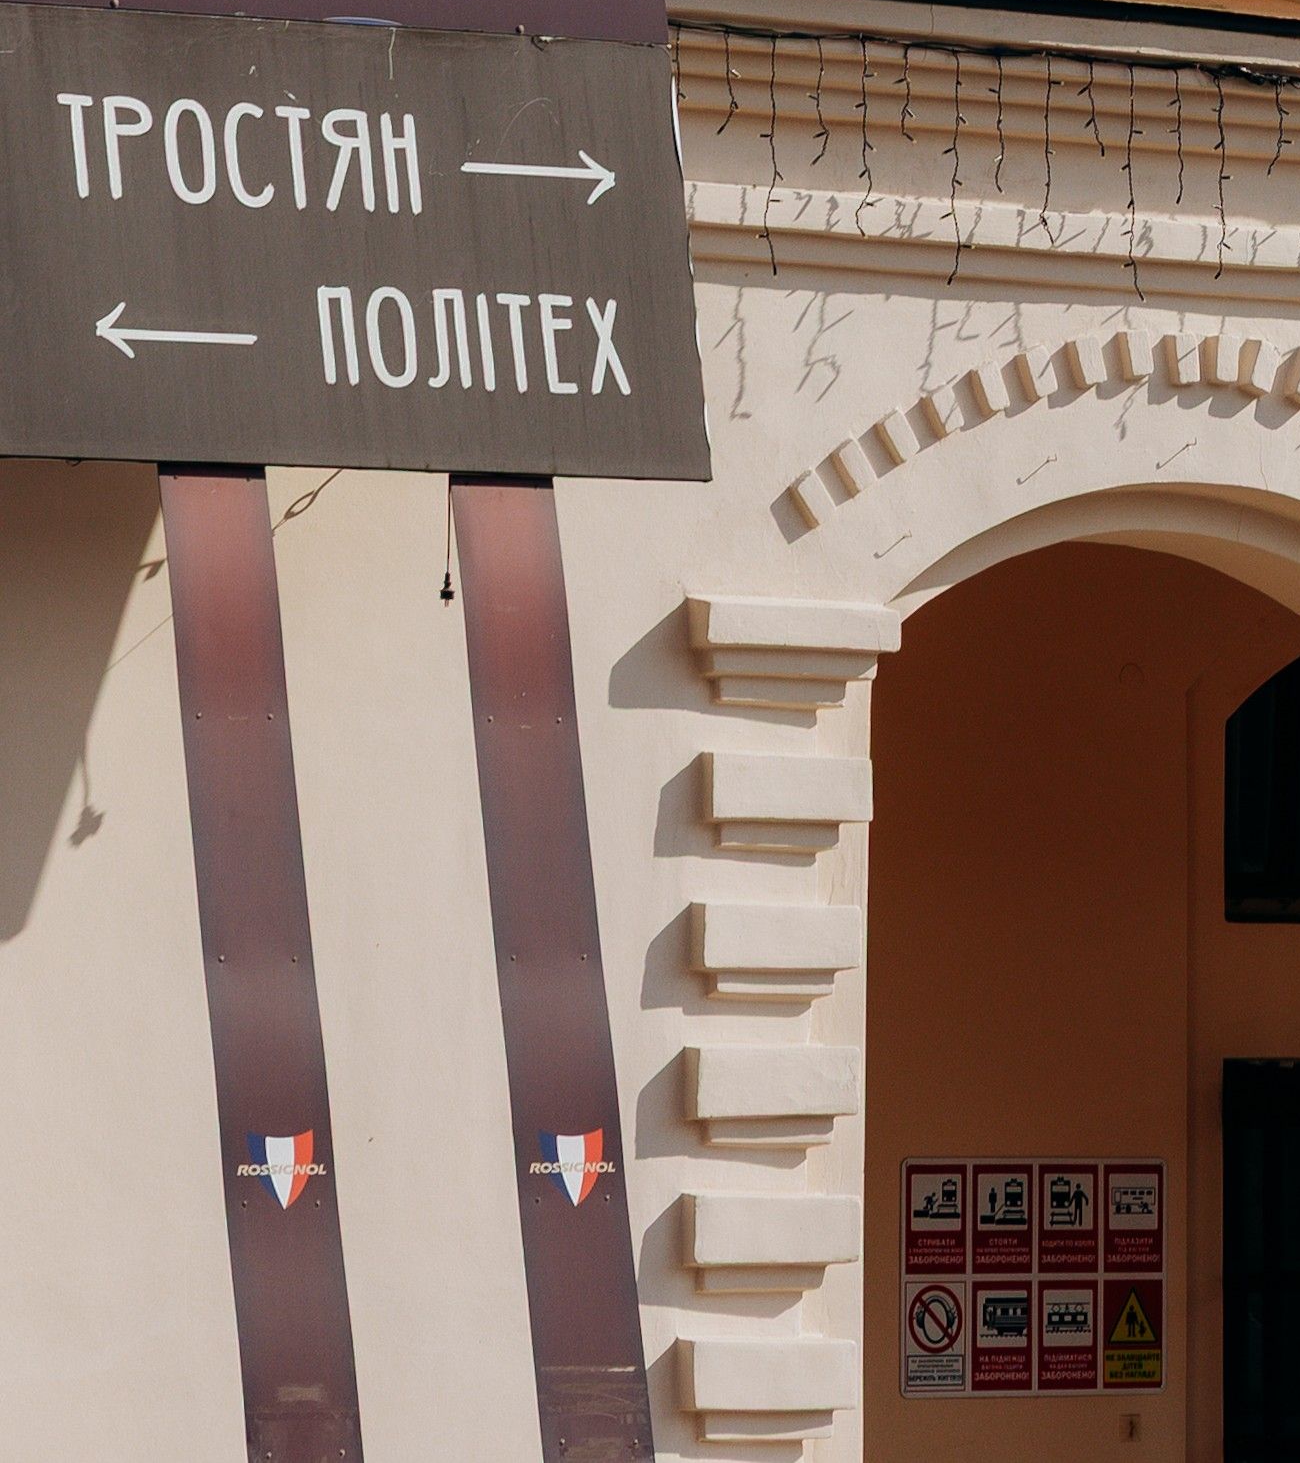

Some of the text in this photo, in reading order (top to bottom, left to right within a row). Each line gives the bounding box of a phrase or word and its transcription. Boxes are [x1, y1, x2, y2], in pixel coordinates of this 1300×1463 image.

[56, 92, 423, 215] ТРОСТЯН
[316, 285, 632, 396] ПОЛІТЕХ
[236, 1163, 328, 1177] ROSSIGNOL
[529, 1161, 616, 1175] ROSSIGNOL
